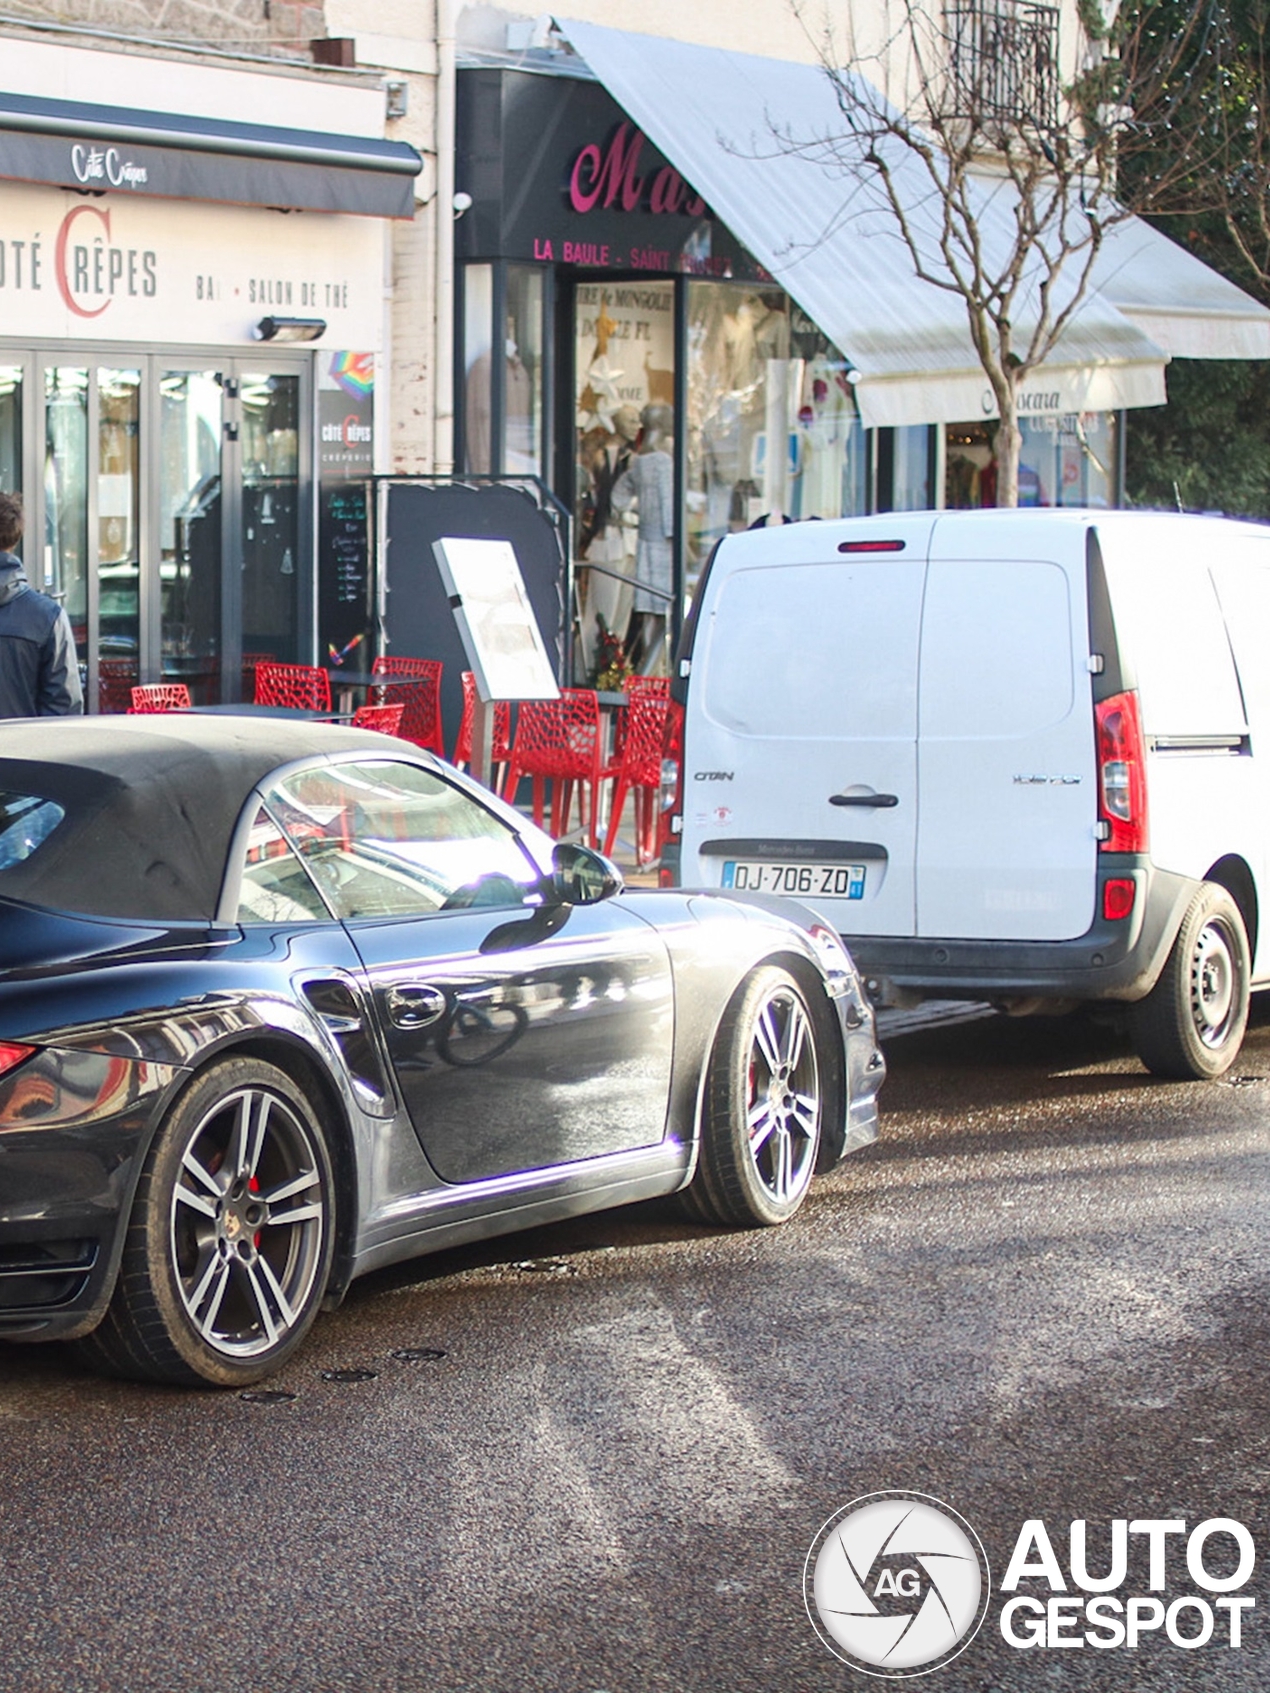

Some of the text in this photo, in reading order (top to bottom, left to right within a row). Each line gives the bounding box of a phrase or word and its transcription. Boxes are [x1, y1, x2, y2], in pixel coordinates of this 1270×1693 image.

[533, 239, 553, 260] LA
[563, 242, 610, 266] BAULE
[249, 279, 292, 305] SALON
[302, 282, 316, 307] DE
